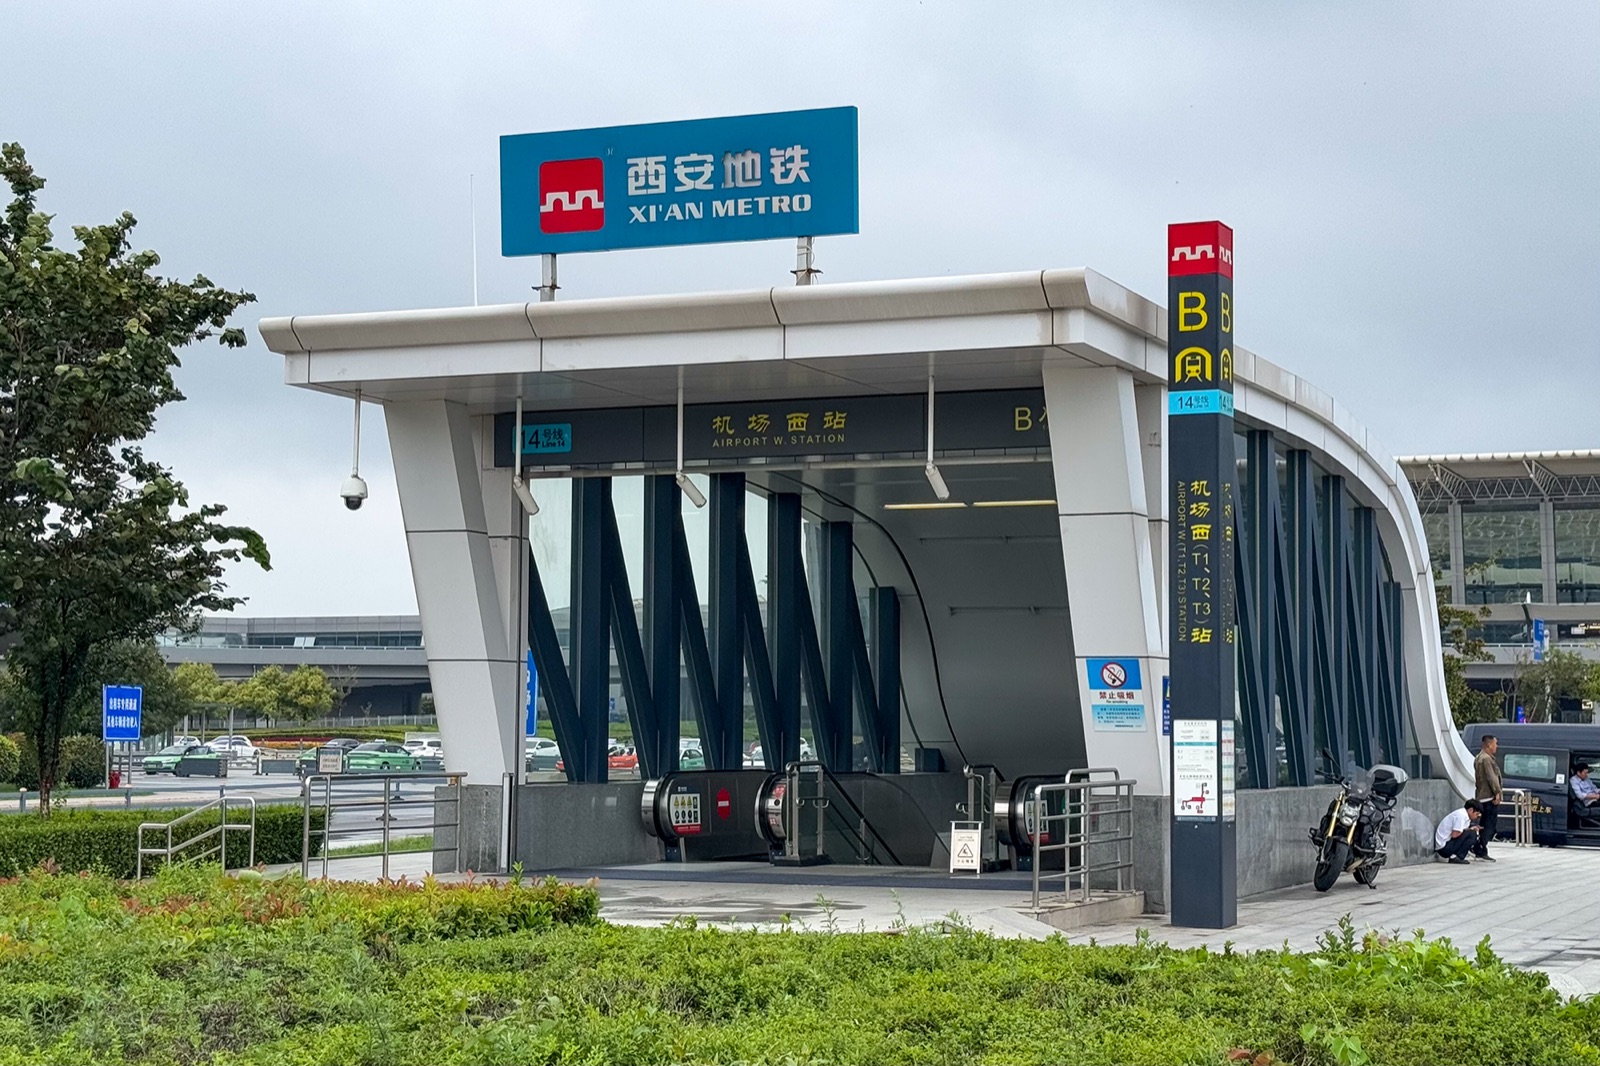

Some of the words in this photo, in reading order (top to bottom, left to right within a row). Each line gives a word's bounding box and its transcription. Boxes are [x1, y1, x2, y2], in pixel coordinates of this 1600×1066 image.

[626, 144, 811, 196] 西安地铁
[628, 201, 703, 224] XI'AN
[711, 194, 812, 219] METRO
[1178, 291, 1208, 332] B
[1221, 292, 1231, 333] B
[712, 410, 847, 435] 机场西站
[1014, 407, 1033, 431] B
[712, 436, 768, 448] AIRPORT
[773, 436, 787, 446] W.
[790, 433, 845, 445] STATION
[1177, 480, 1187, 527] AIRPORT
[1177, 597, 1187, 642] STATION
[1099, 691, 1134, 700] 禁止吸烟
